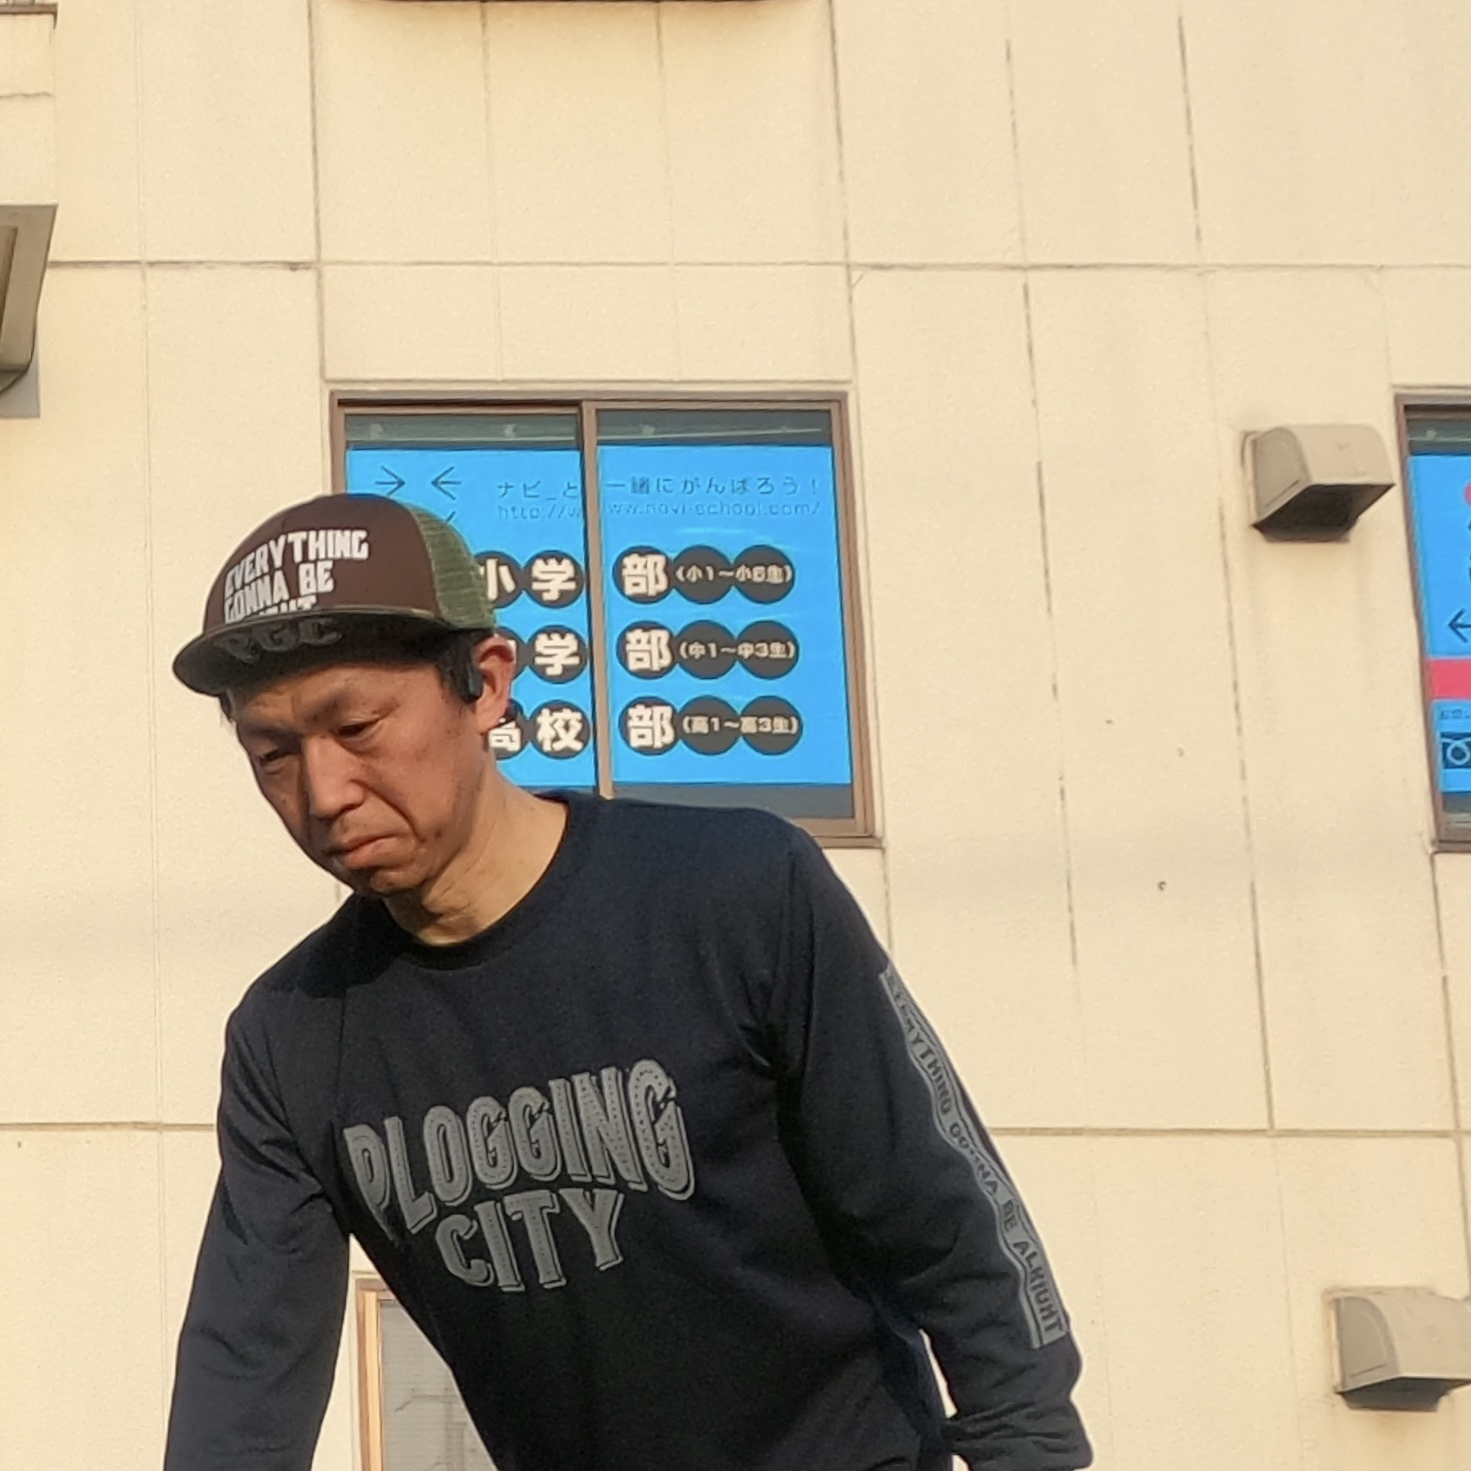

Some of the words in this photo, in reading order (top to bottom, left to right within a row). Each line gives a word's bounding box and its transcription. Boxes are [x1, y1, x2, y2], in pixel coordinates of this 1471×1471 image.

[224, 570, 289, 624] GONNA
[298, 561, 334, 595] BE
[226, 530, 369, 597] EVERYTHING
[343, 1059, 695, 1241] PLOGGING
[435, 1189, 624, 1292] CITY
